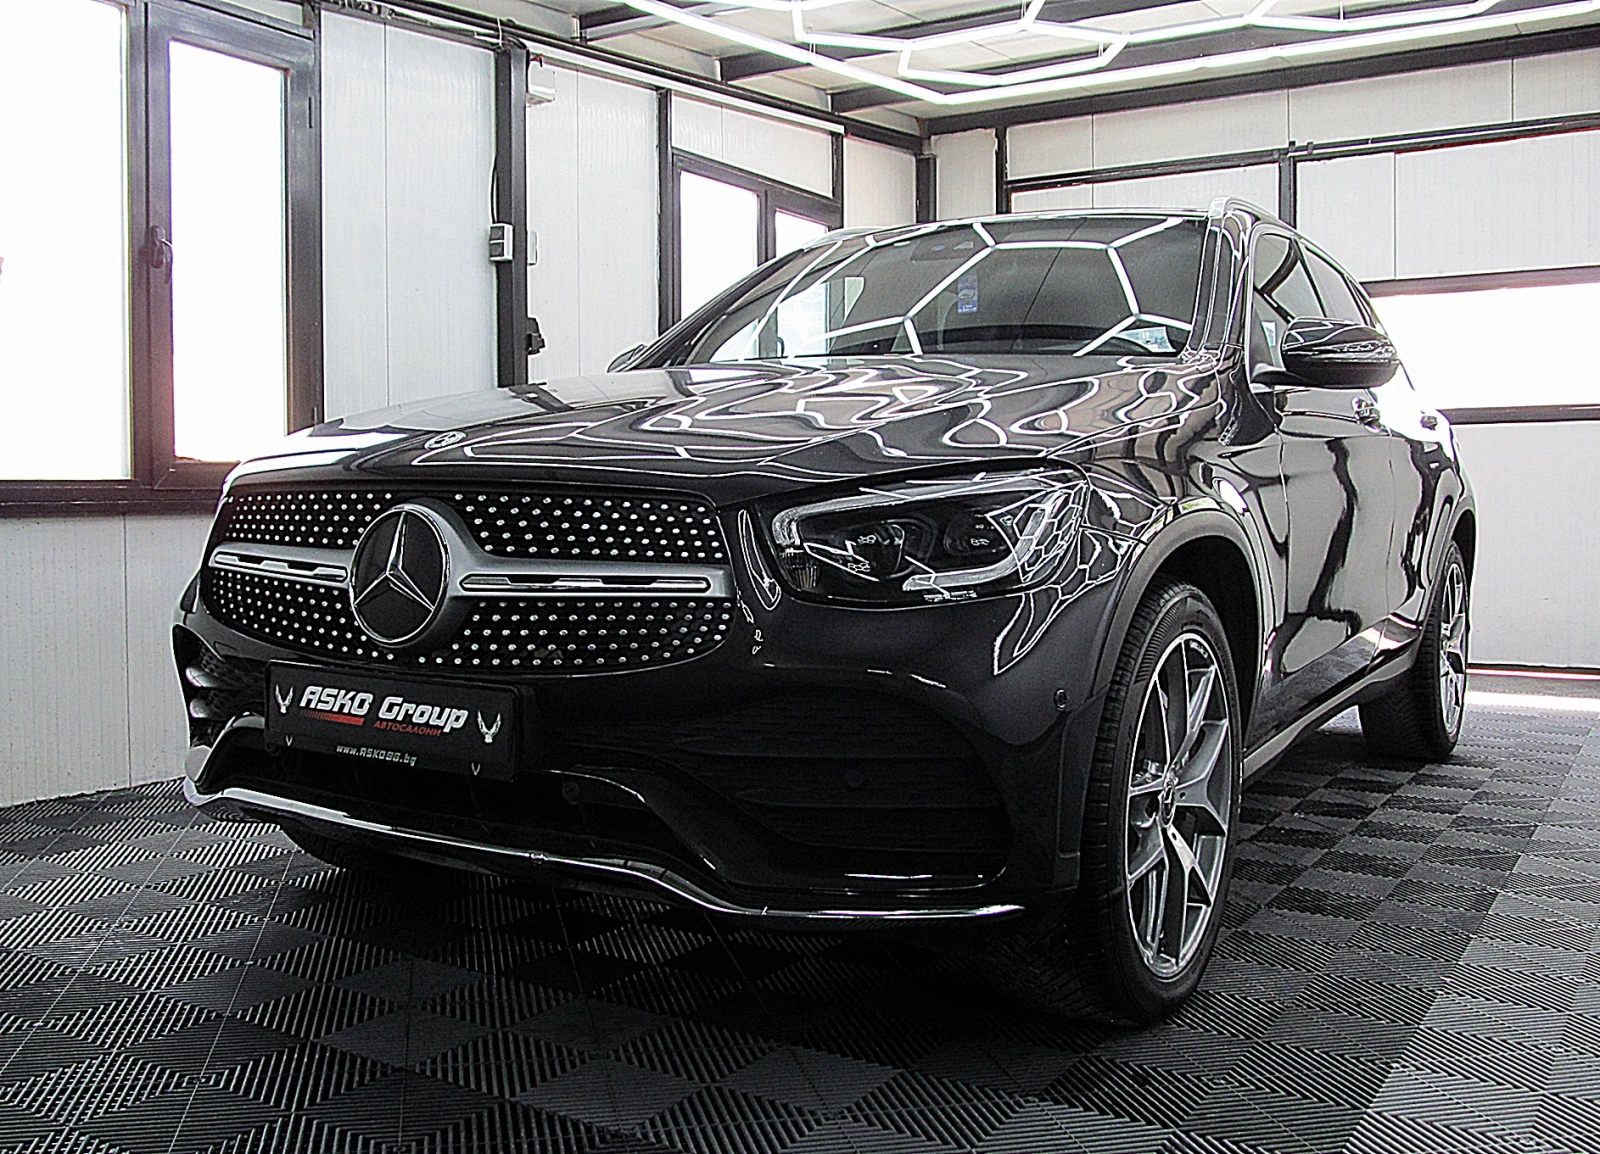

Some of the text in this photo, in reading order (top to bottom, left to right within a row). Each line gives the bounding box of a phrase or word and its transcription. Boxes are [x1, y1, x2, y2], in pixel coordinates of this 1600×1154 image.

[300, 686, 469, 732] ASKO Group
[374, 720, 442, 736] АВТОСАЛОНИ
